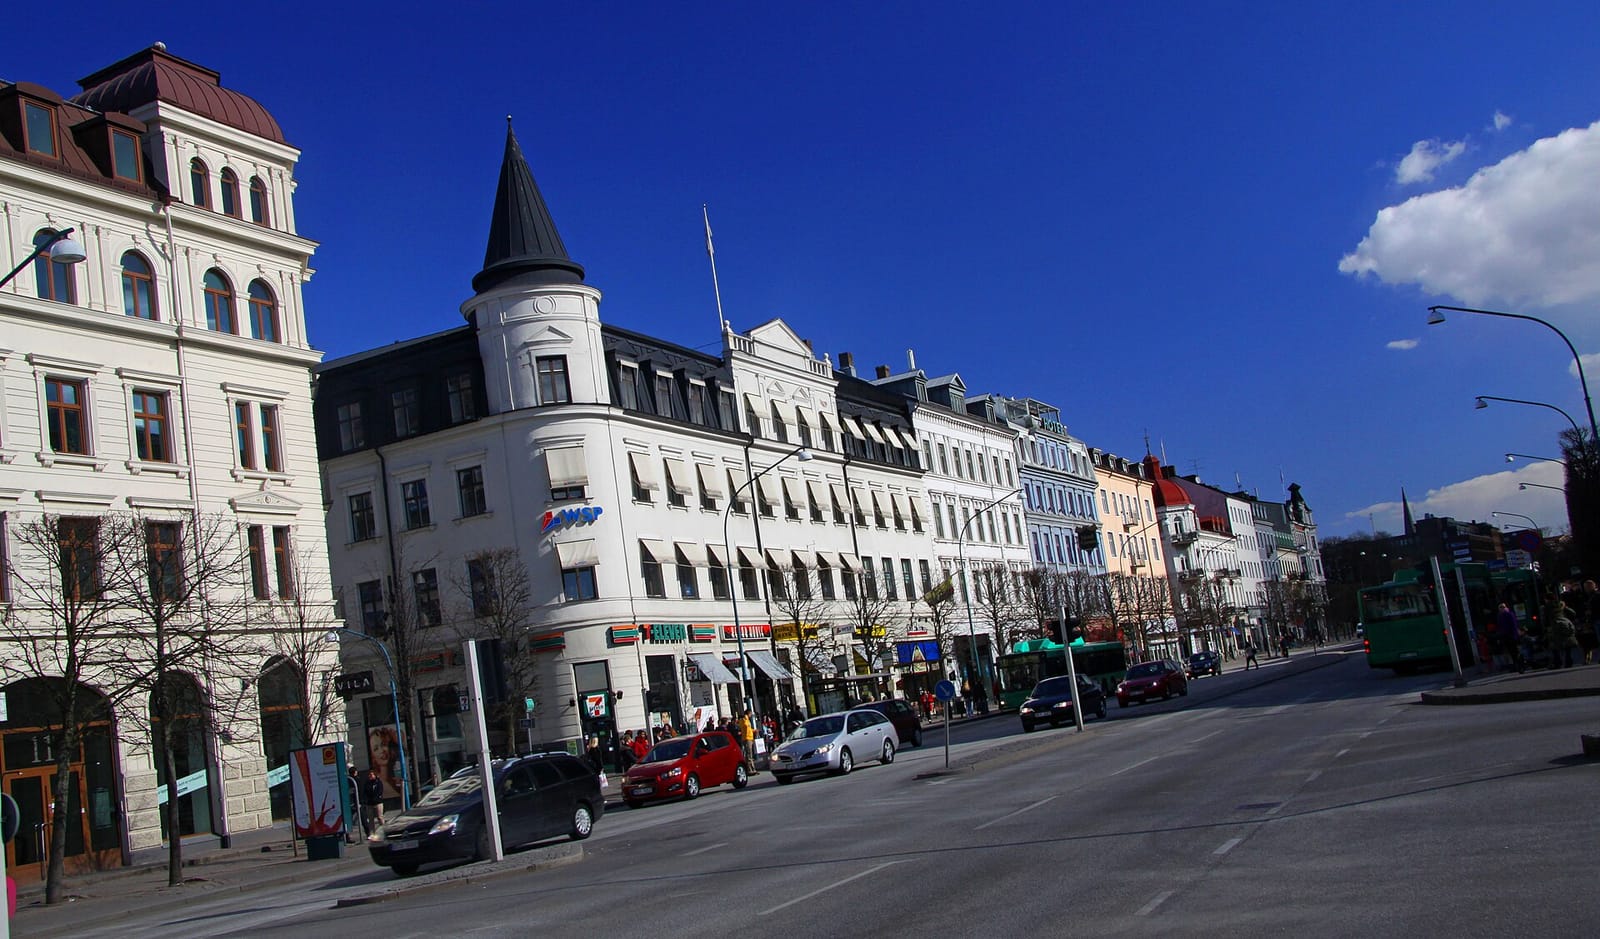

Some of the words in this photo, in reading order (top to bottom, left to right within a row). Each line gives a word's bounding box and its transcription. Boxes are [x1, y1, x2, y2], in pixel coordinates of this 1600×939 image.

[561, 506, 603, 523] WSP
[336, 677, 370, 691] VILA
[588, 696, 603, 716] 7
[31, 735, 55, 763] 11
